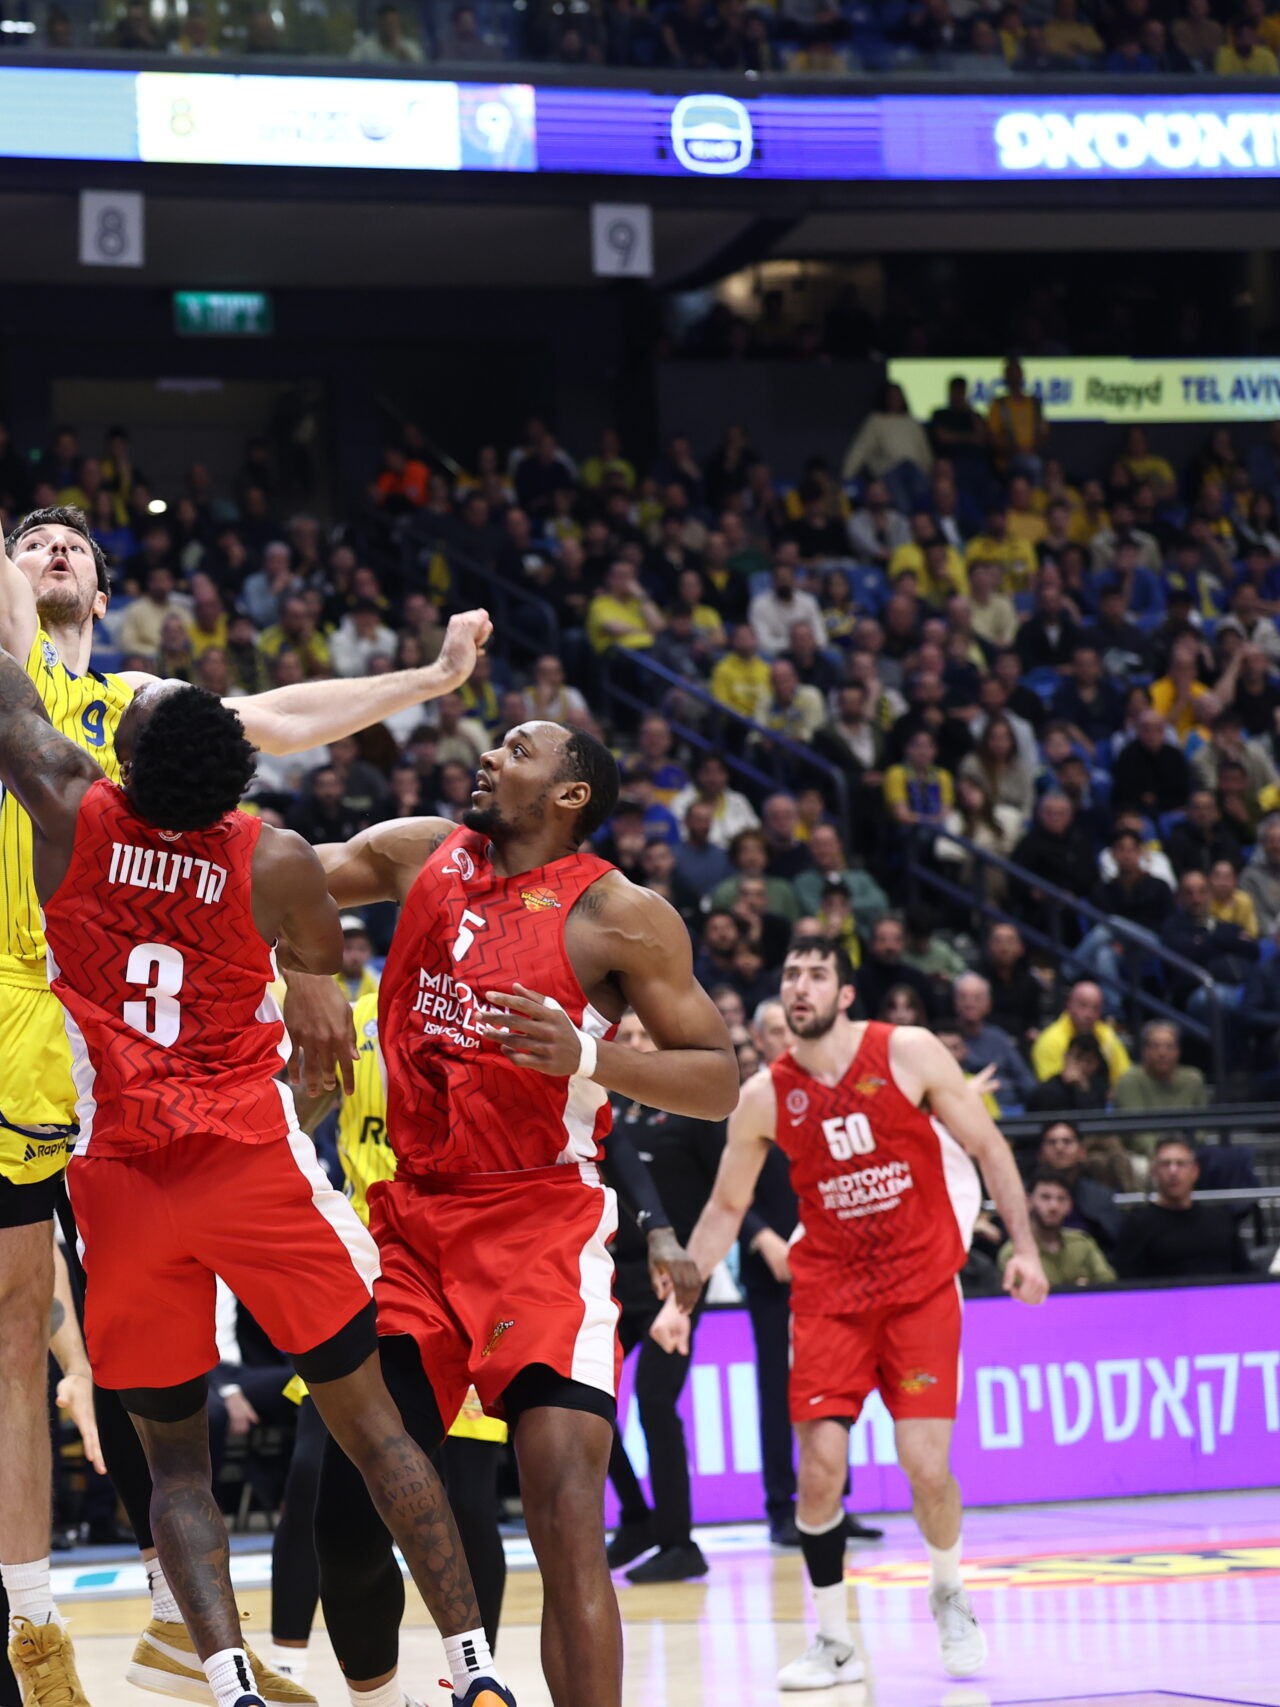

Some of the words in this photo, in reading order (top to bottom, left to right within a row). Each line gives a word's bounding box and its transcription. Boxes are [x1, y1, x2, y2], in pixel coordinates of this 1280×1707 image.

[95, 206, 128, 258] 8
[606, 219, 637, 268] 9
[81, 700, 107, 747] 9
[108, 841, 228, 905] קרינגטון
[452, 909, 486, 962] 5
[123, 943, 184, 1048] 3
[821, 1112, 876, 1161] 50
[818, 1161, 910, 1194] MIDTOWN
[823, 1174, 913, 1210] JERUSALEM
[382, 1460, 423, 1484] VENI
[387, 1477, 431, 1501] VIDI
[396, 1493, 437, 1518] VICI
